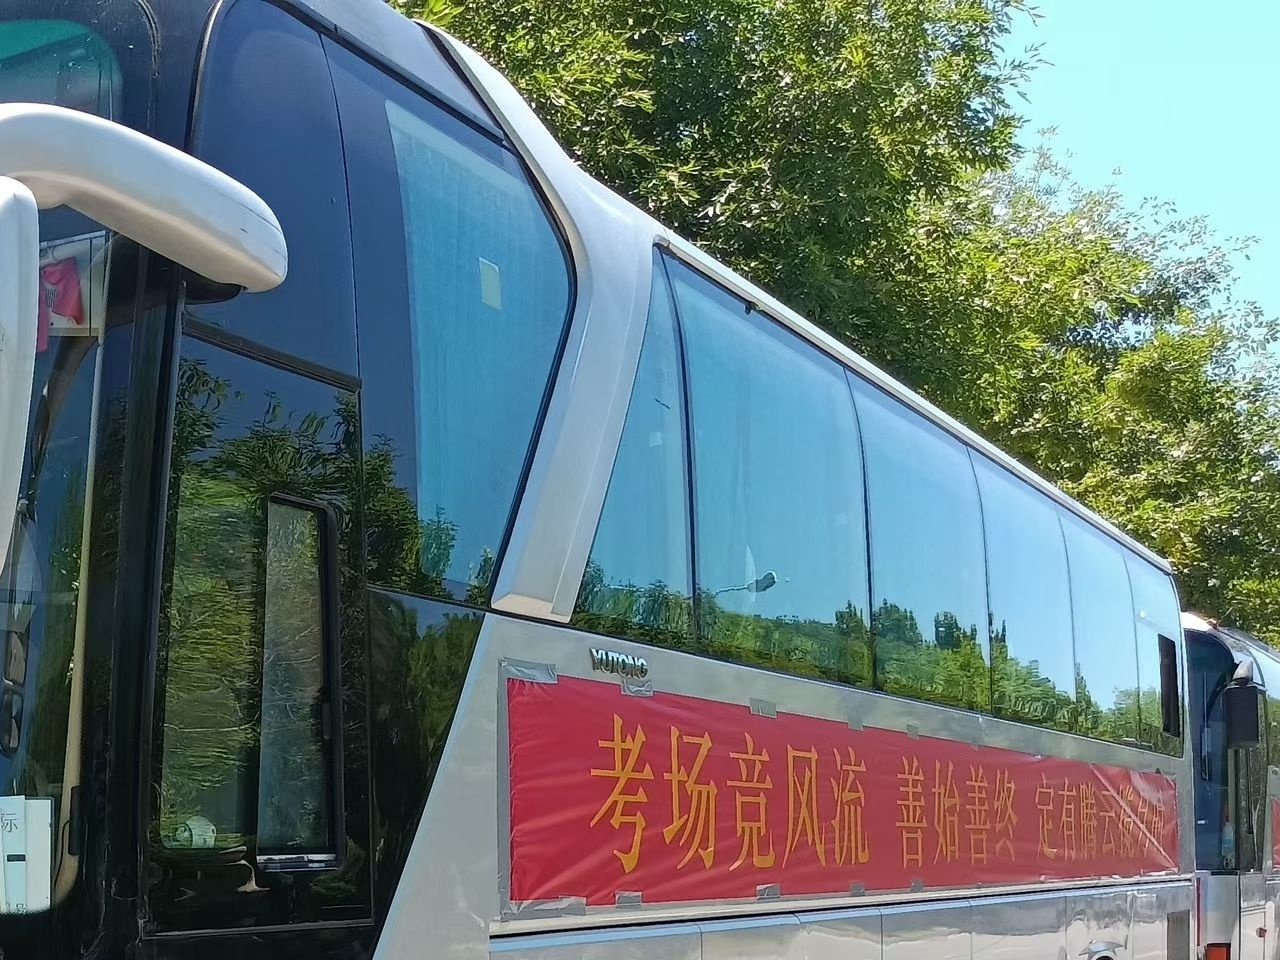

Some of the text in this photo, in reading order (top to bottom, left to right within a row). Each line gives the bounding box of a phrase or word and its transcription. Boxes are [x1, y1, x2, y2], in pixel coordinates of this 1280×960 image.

[589, 648, 648, 679] YUTONG
[589, 713, 869, 874] 考场竞风流
[895, 755, 1019, 869] 善始善终
